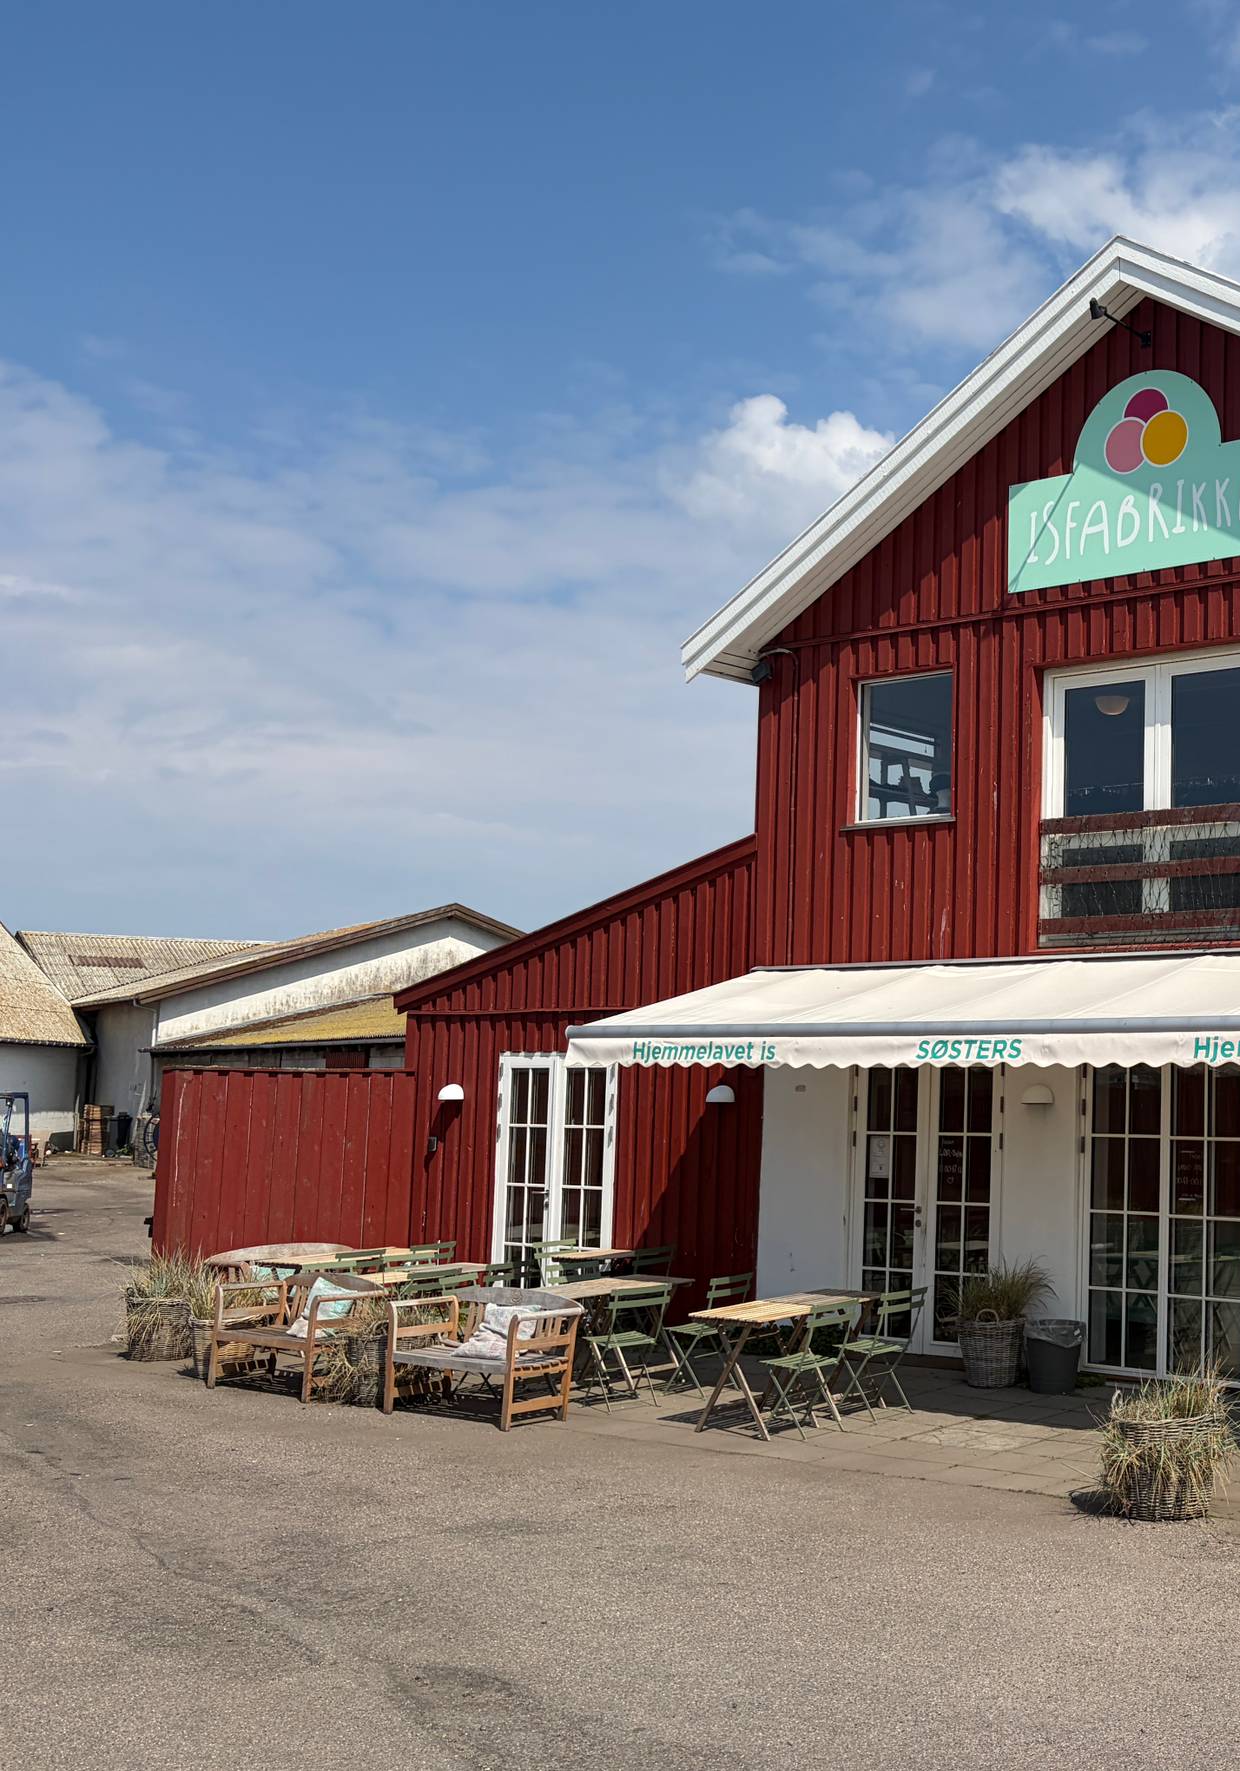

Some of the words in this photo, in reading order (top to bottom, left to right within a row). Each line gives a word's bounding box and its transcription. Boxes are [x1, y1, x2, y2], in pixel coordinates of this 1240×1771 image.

[632, 1041, 753, 1063] Hjemmelavet
[760, 1041, 776, 1061] is
[915, 1039, 1023, 1060] SØSTERS
